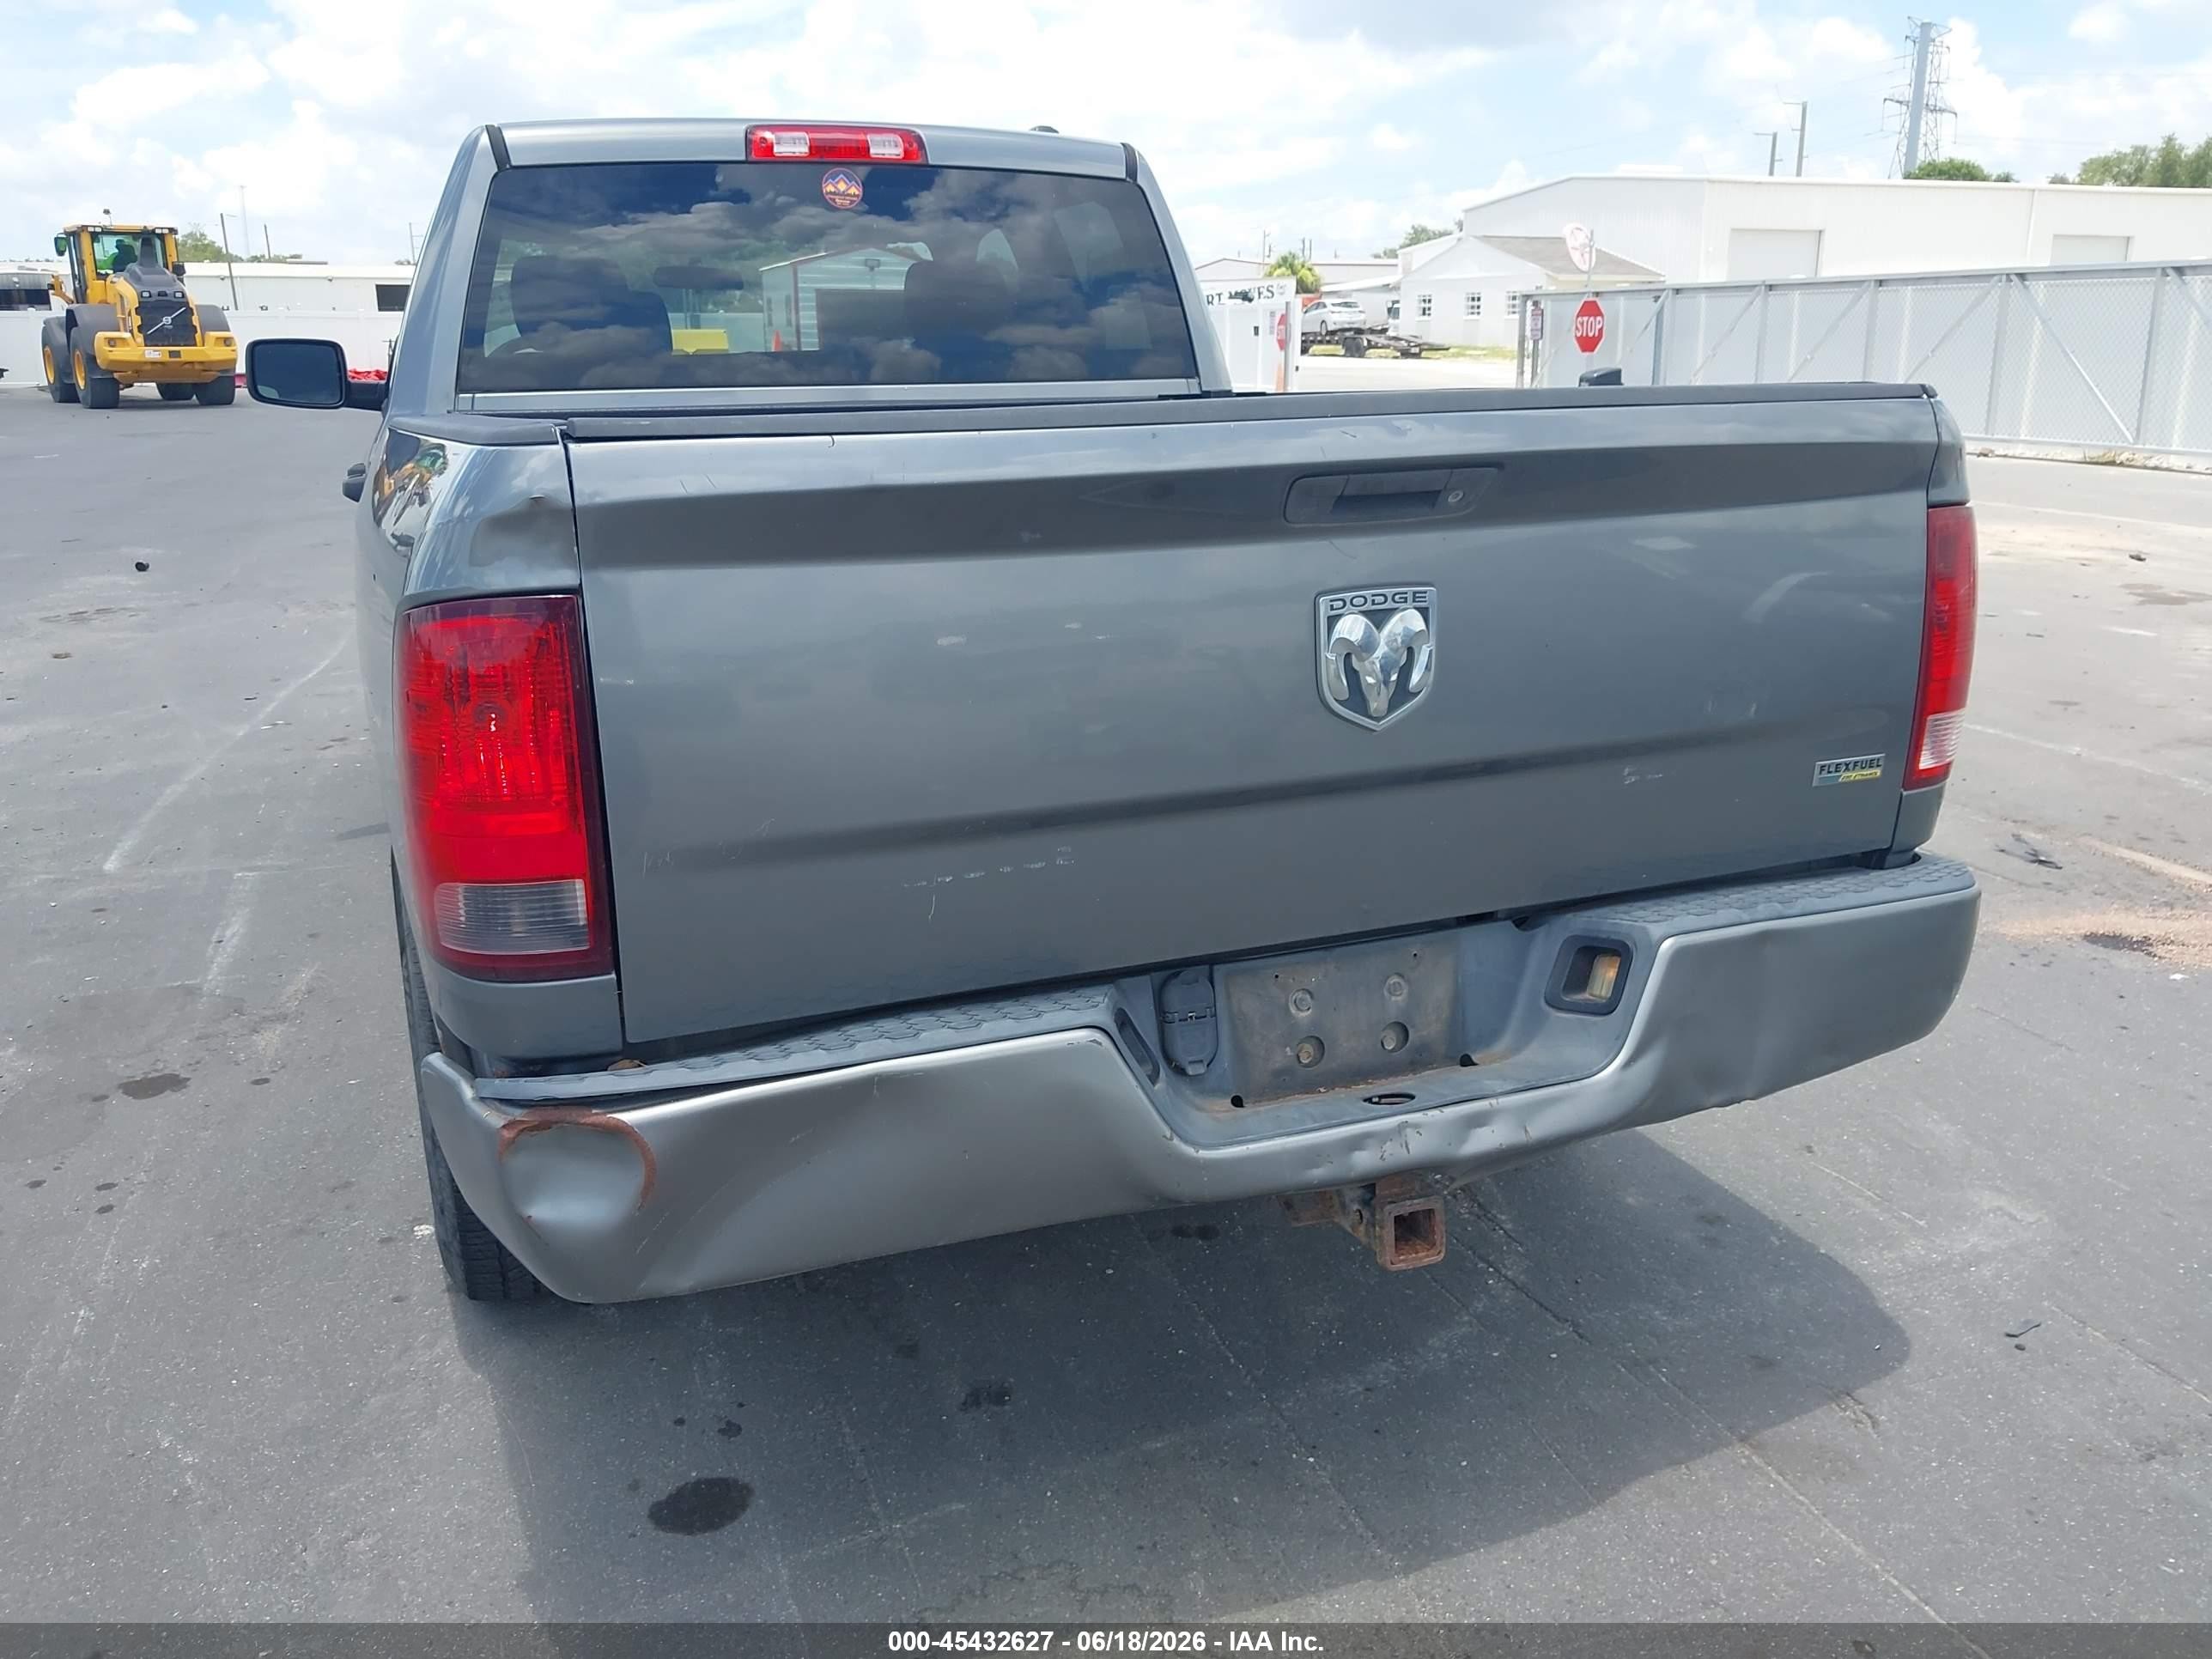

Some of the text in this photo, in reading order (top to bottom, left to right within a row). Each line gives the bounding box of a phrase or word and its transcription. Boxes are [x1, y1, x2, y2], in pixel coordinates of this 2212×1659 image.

[1576, 316, 1603, 337] STOP
[1328, 591, 1427, 611] DODGE
[1819, 758, 1882, 775] FLEXFUEL
